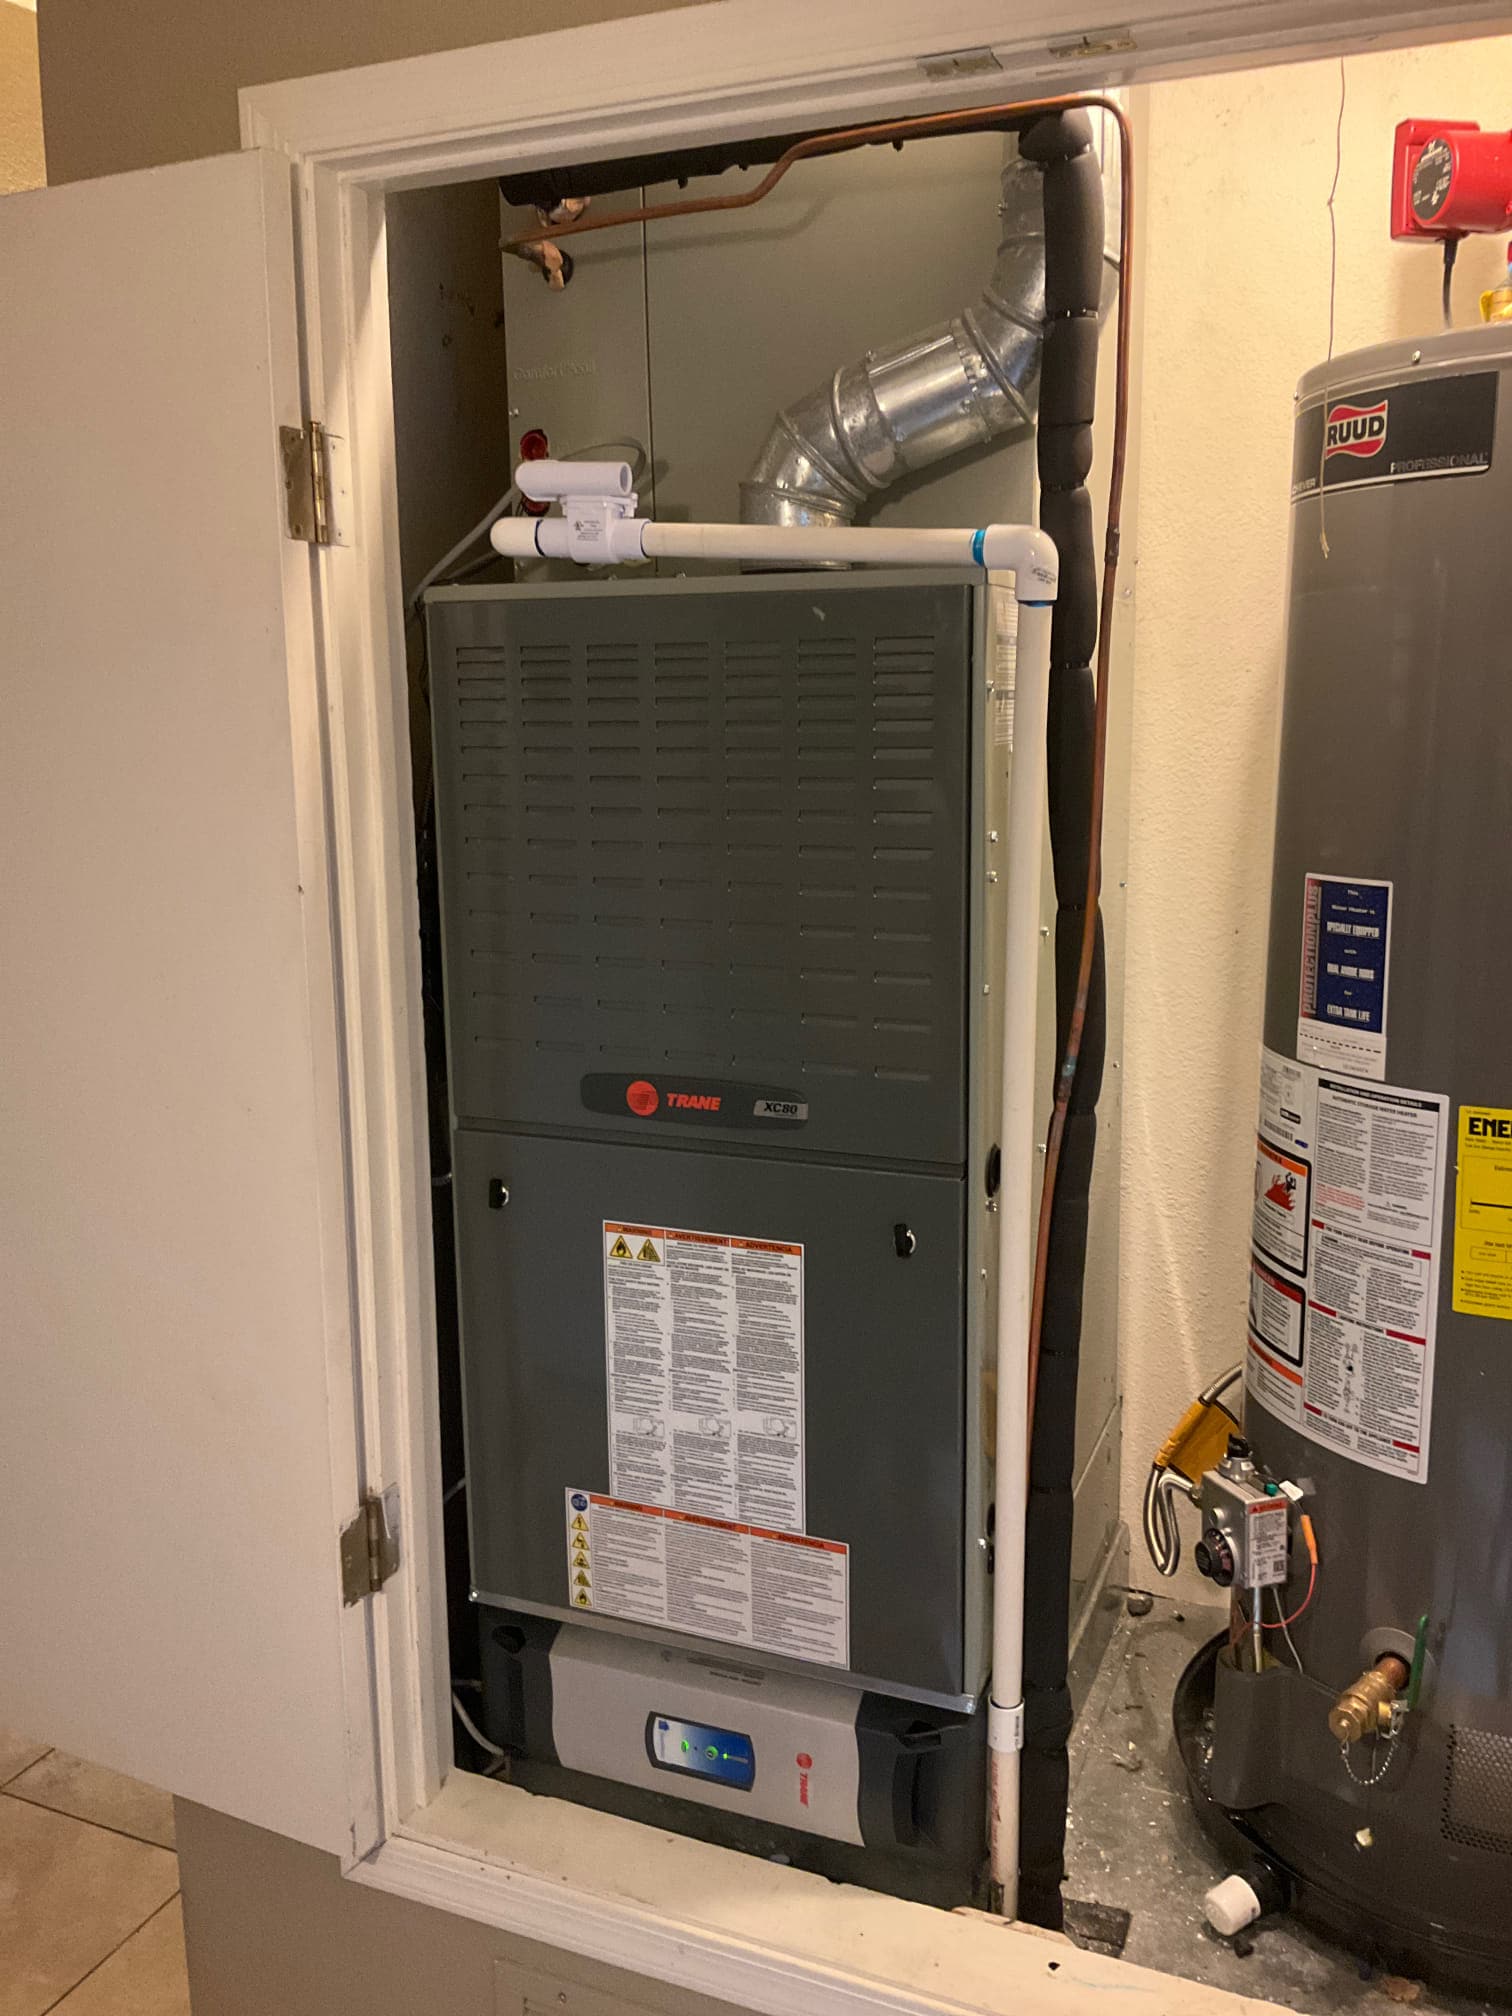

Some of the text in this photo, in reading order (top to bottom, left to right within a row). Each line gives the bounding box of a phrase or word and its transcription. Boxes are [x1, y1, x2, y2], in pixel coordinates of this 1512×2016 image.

[1327, 415, 1385, 446] RUUD
[667, 1093, 721, 1111] TRANE
[764, 1102, 798, 1114] XC80
[1469, 1117, 1512, 1138] ENE
